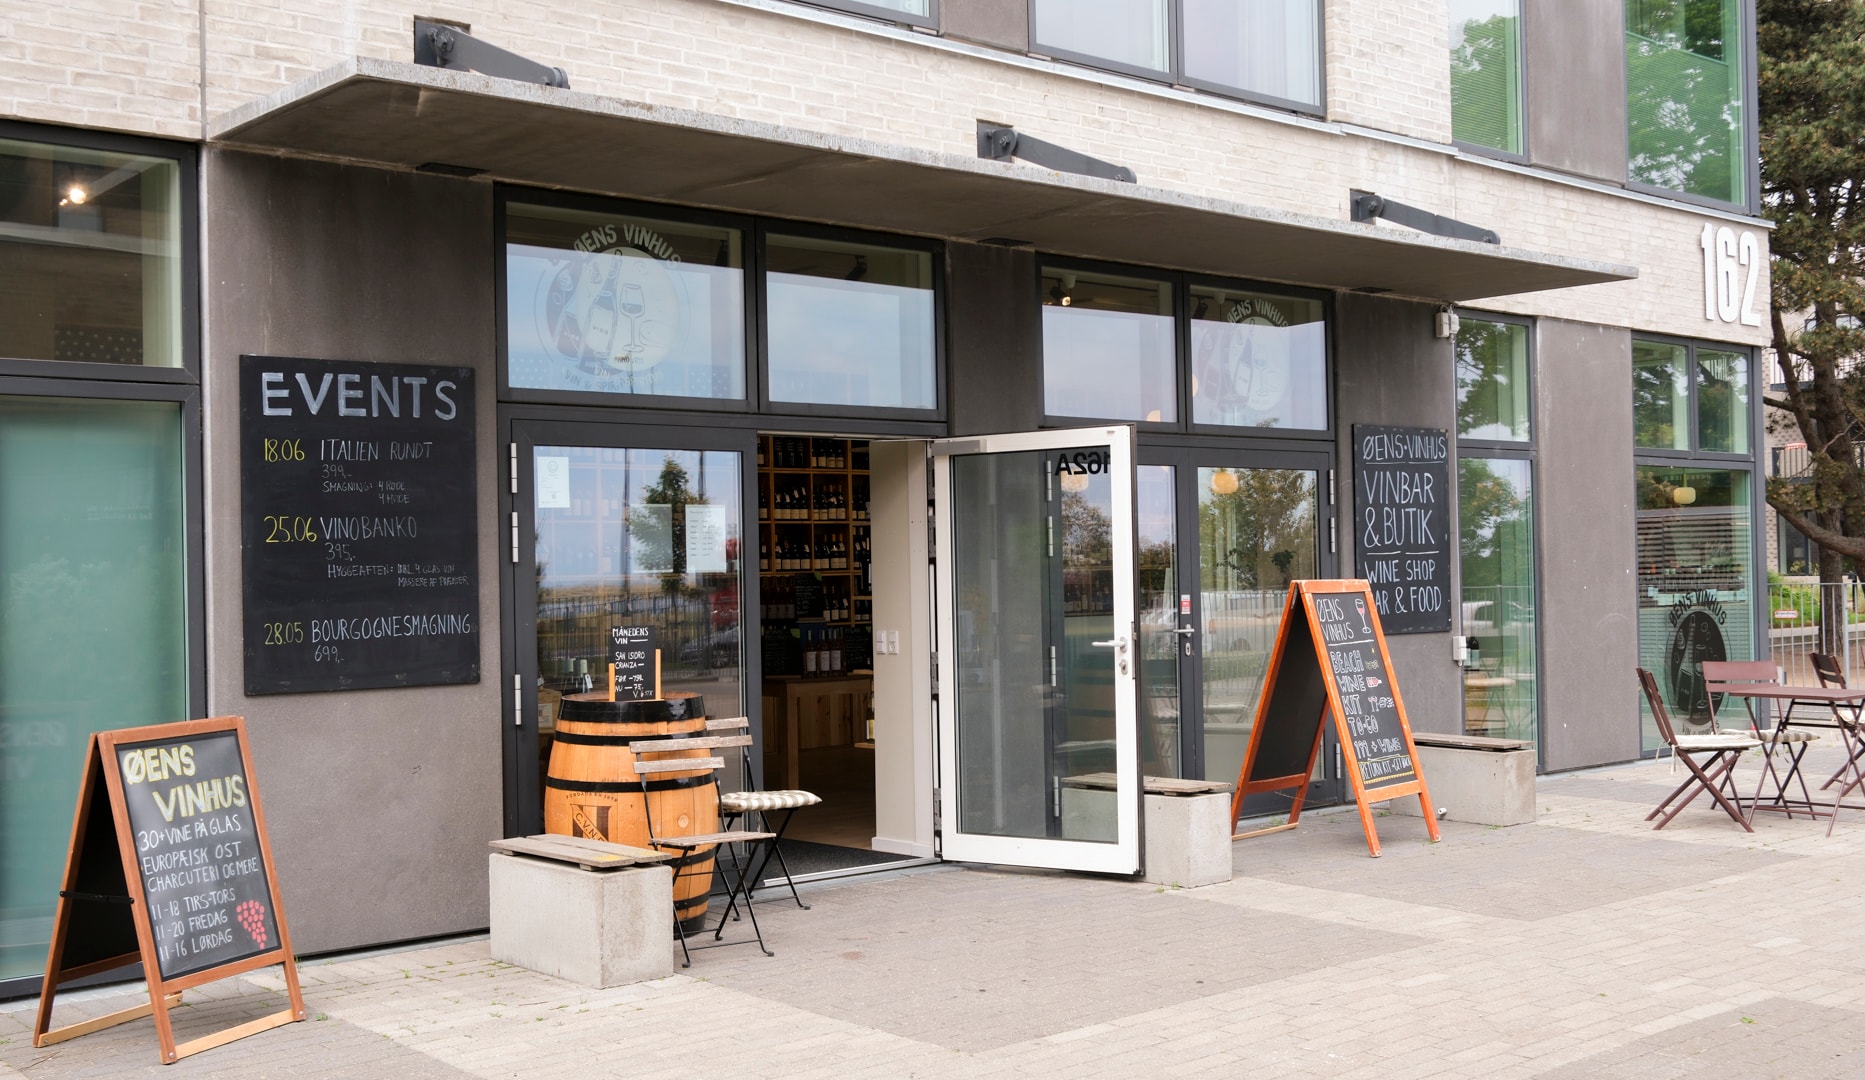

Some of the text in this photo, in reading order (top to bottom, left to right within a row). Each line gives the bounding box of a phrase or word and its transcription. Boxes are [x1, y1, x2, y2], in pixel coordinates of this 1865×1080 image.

[1701, 222, 1761, 327] 162
[262, 372, 457, 420] EVENTS
[265, 438, 433, 462] 18.06 ITALIEN RUNDT
[1363, 470, 1435, 505] VINBAR
[264, 515, 417, 543] 25.06 VINOBANKO
[1364, 506, 1435, 548] & BUTIK
[1364, 559, 1436, 584] WINE SHOP
[1316, 598, 1345, 623] ØENS
[1375, 586, 1442, 615] AR & FOOD
[1695, 590, 1727, 626] VINHUS
[264, 614, 471, 645] 28.05 BOURGOGNESMAGNING
[615, 637, 628, 645] VIN
[1321, 621, 1355, 642] VINHUS
[1336, 674, 1367, 693] WINE
[123, 745, 197, 786] ØENS
[152, 774, 246, 823] VINHUS
[209, 814, 243, 839] GLAS
[143, 841, 242, 876] EUROPÆISK OST
[147, 865, 219, 893] CHARCUTERI
[188, 909, 228, 932] FREDAG
[190, 928, 233, 951] LØRDAG
